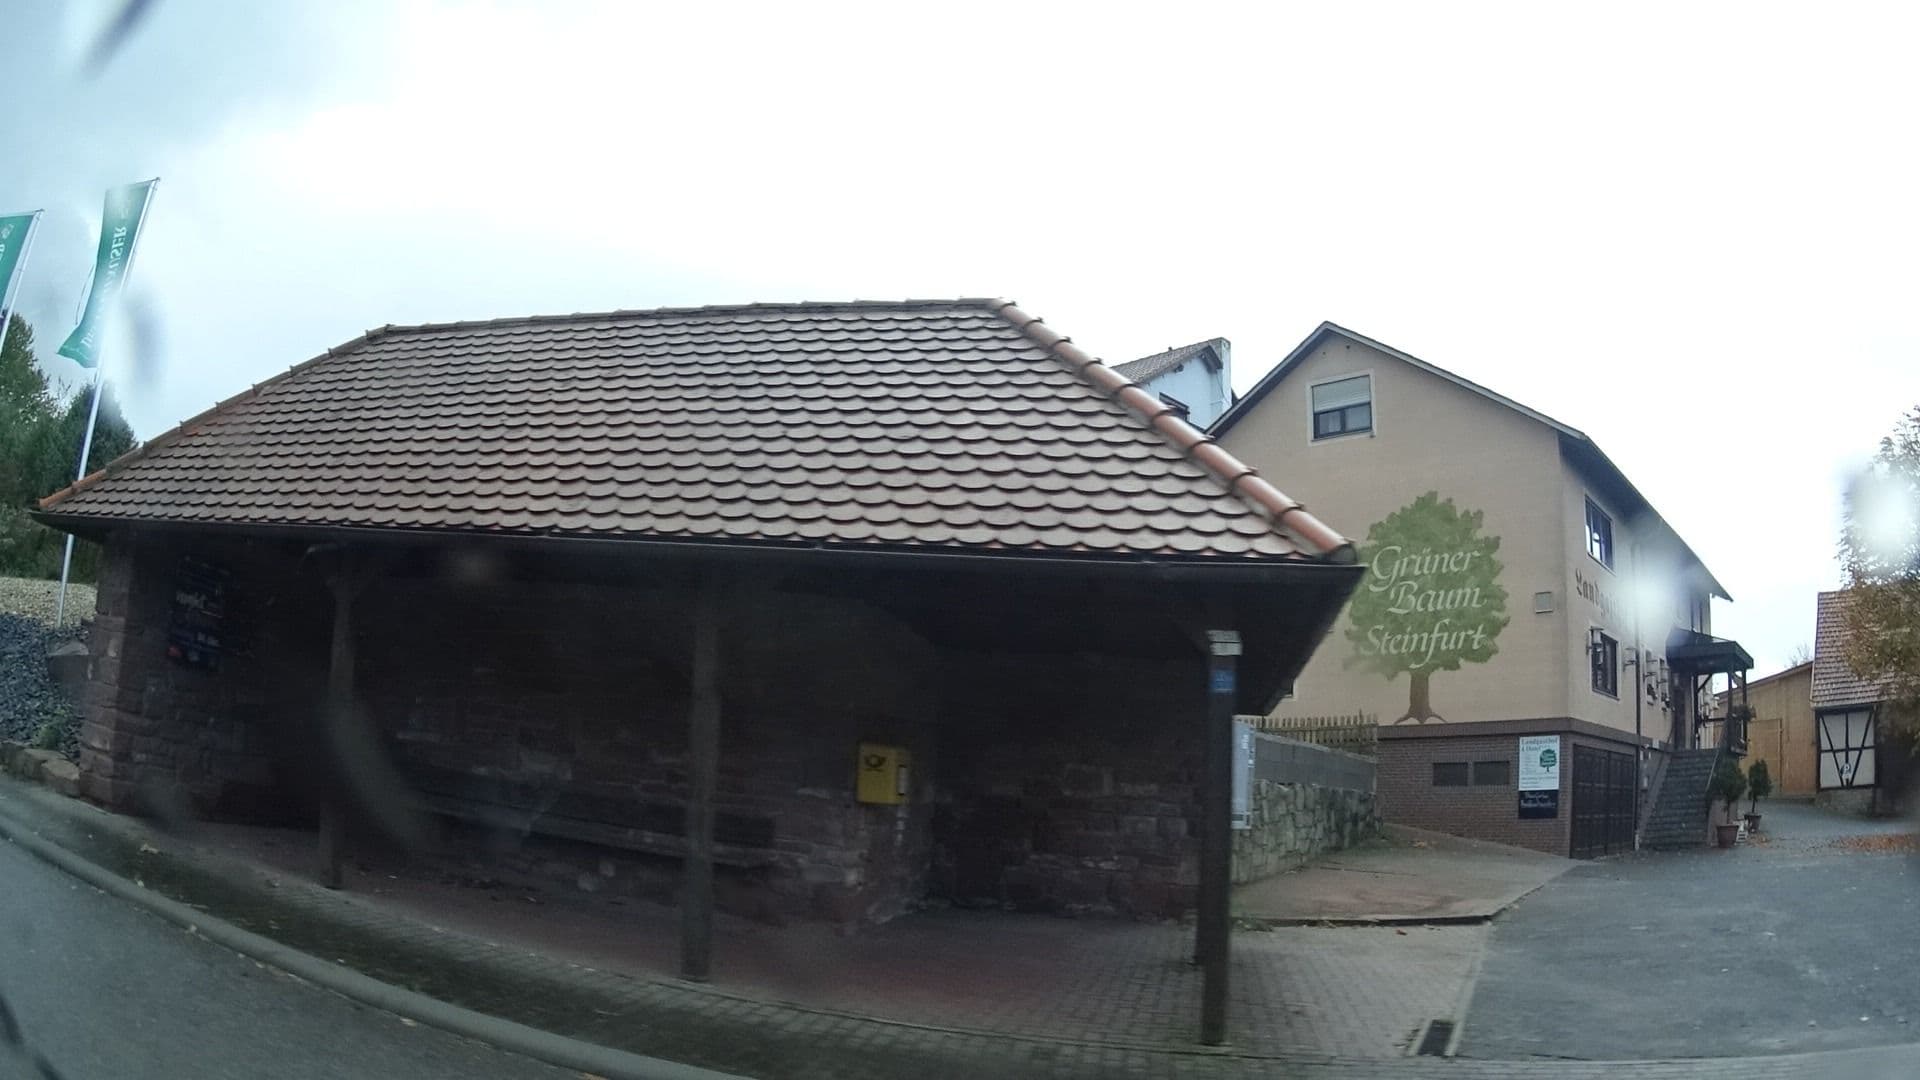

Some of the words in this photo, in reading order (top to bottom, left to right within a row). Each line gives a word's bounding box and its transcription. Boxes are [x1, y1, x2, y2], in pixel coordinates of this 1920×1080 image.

[1369, 546, 1481, 592] Grüner
[1387, 581, 1487, 614] Baum
[1360, 619, 1487, 669] Steinfurt
